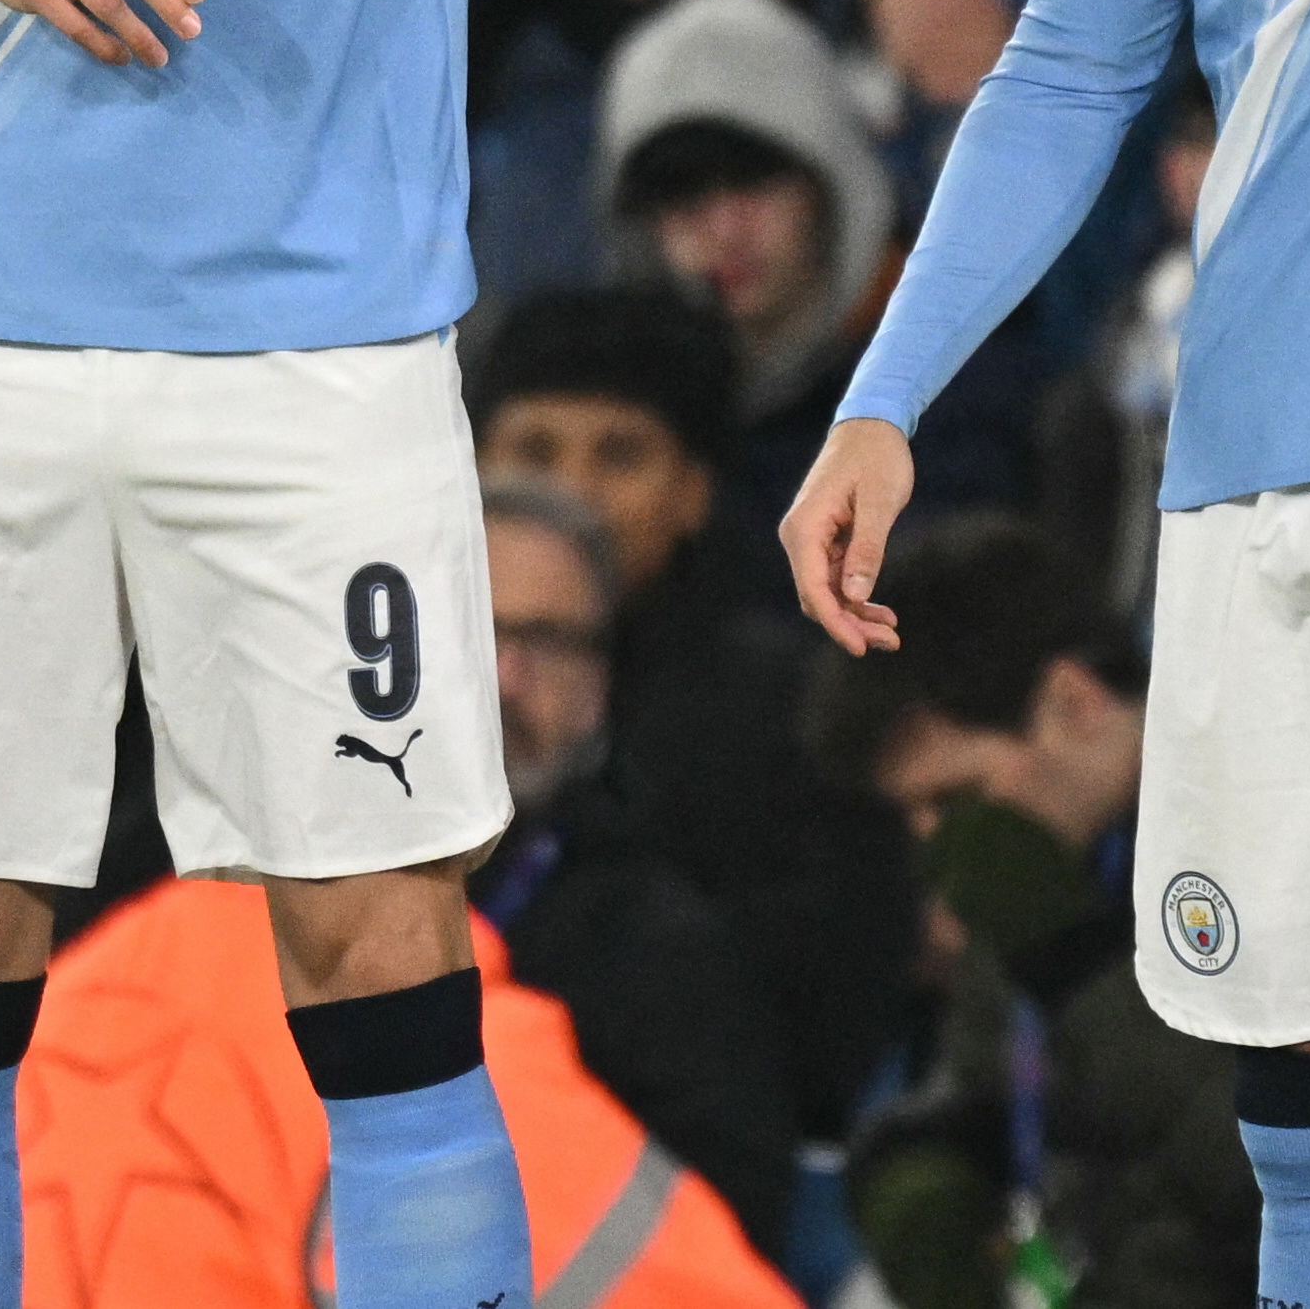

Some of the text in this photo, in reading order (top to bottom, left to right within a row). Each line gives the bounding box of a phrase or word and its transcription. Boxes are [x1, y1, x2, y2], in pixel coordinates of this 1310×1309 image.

[344, 561, 422, 721] 9
[1168, 879, 1226, 911] MANCHESTER
[1198, 957, 1220, 968] CITY
